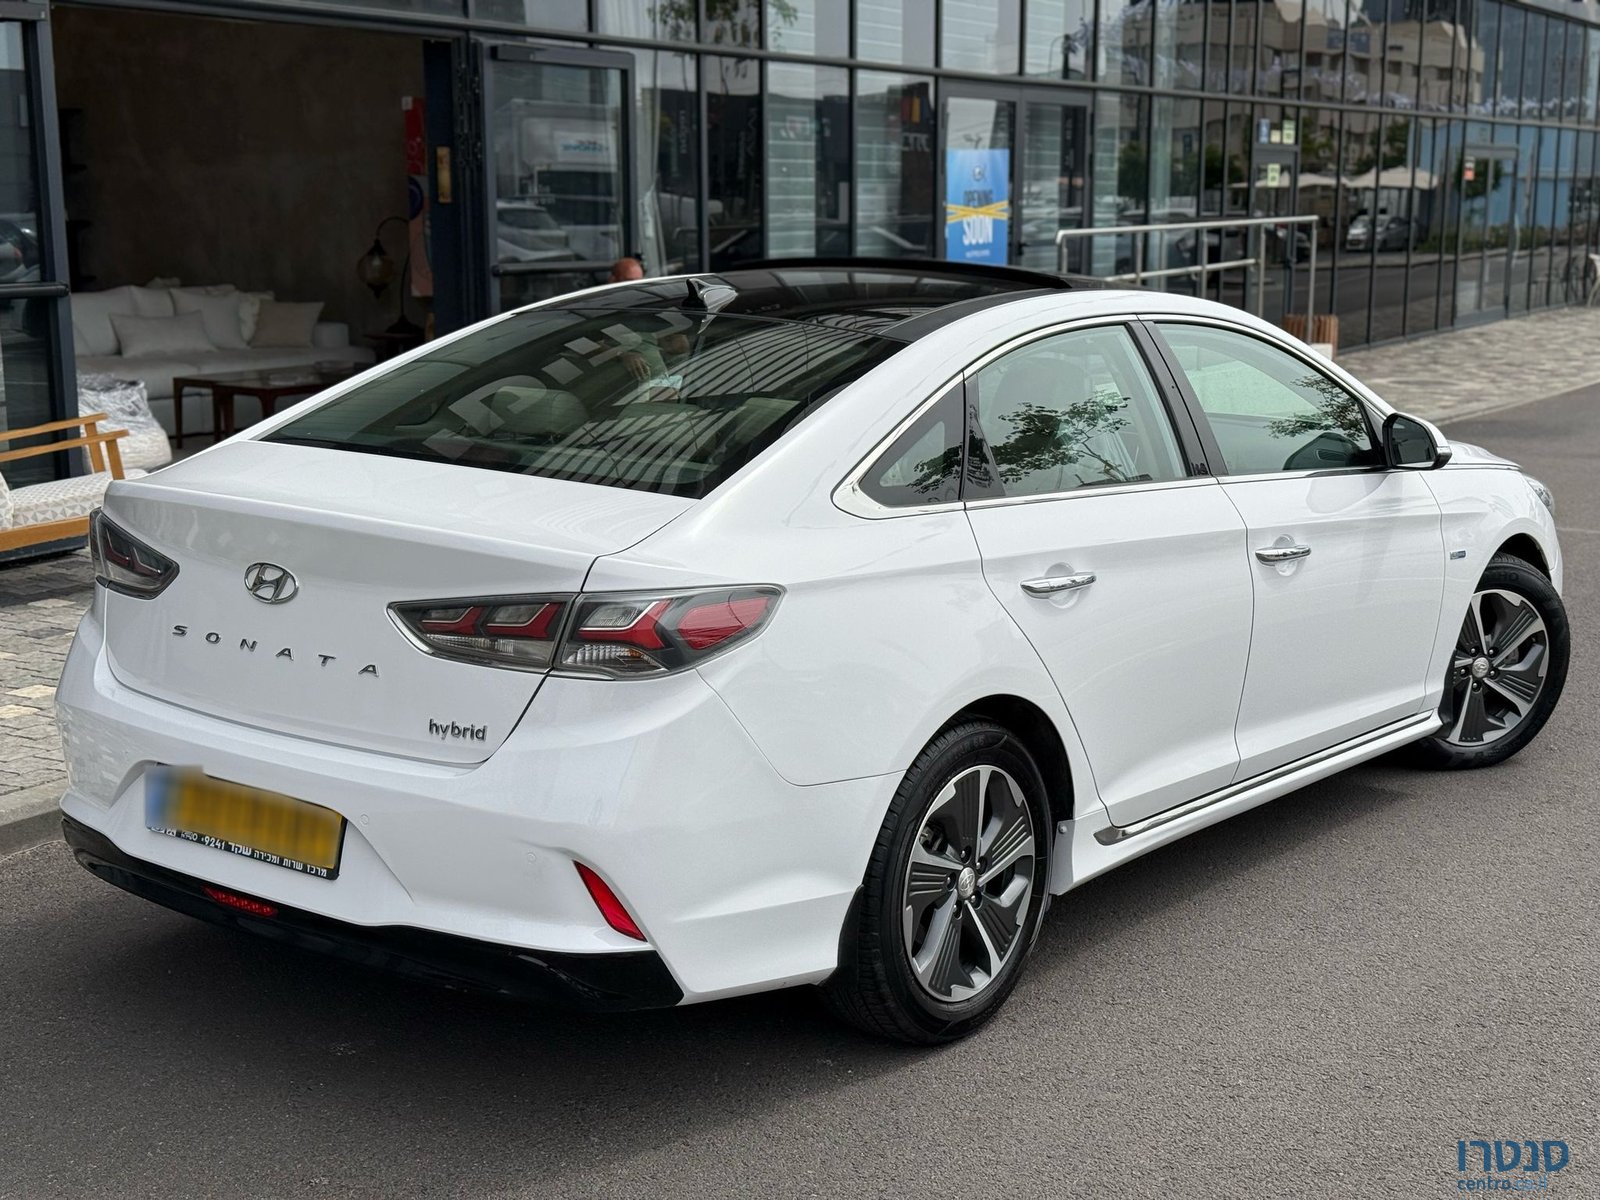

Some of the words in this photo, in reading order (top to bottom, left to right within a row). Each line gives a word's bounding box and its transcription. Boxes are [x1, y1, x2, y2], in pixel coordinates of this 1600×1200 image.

[962, 215, 993, 246] SOON
[172, 624, 379, 677] SONATA
[428, 718, 487, 741] hybrid
[228, 841, 252, 856] שקד
[254, 850, 280, 863] ומכירה
[283, 859, 303, 870] שרות
[307, 865, 327, 876] מרכז
